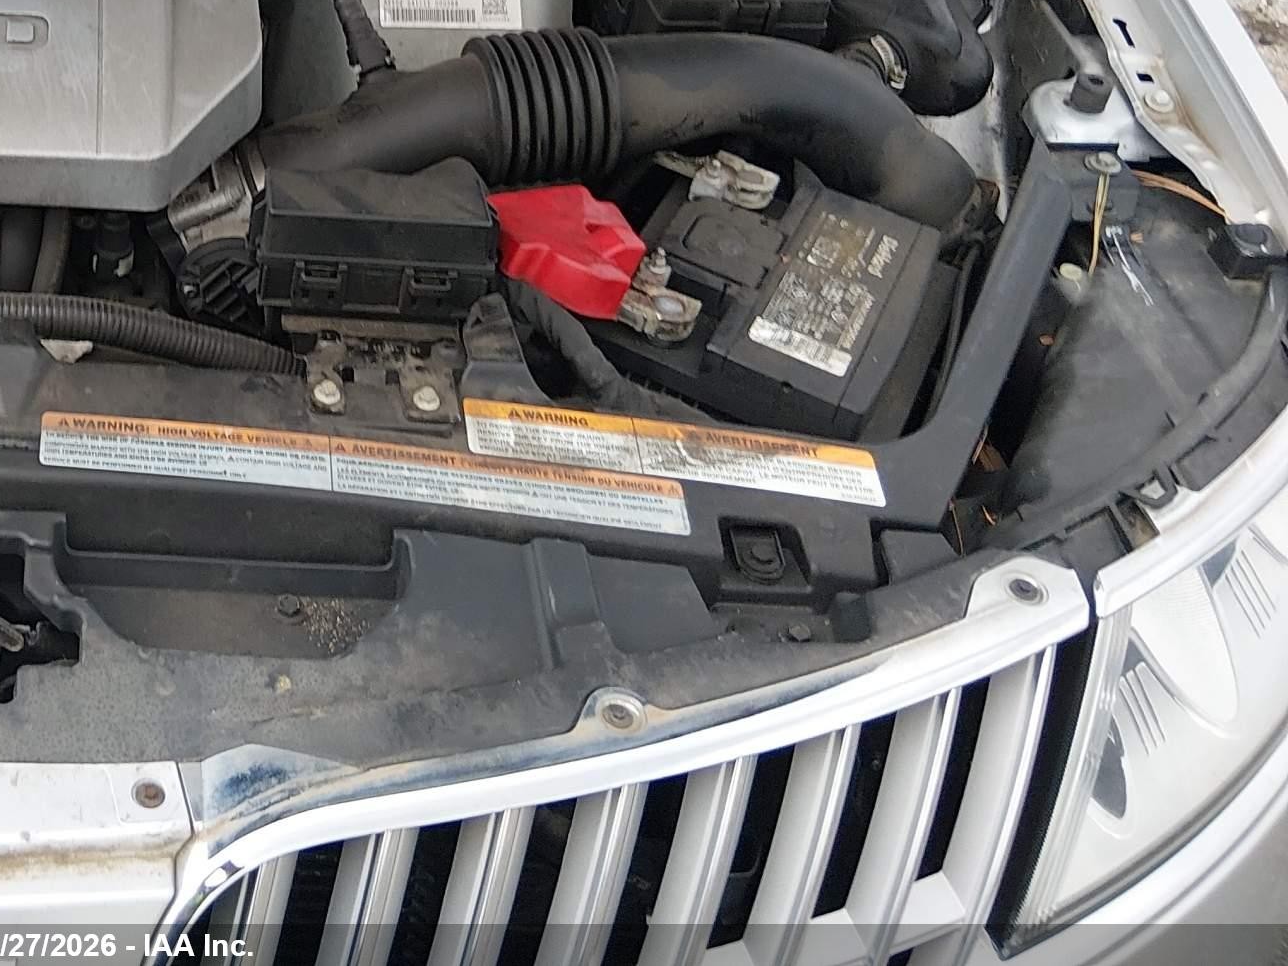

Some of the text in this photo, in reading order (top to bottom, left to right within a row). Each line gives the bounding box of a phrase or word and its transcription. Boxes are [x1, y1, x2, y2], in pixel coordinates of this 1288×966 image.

[523, 410, 590, 427] WARNING
[158, 425, 187, 437] HIGH
[190, 429, 243, 442] VOLTAGE
[351, 443, 457, 465] AVERTISSEMENT
[705, 433, 818, 459] AVERTISSEMENT
